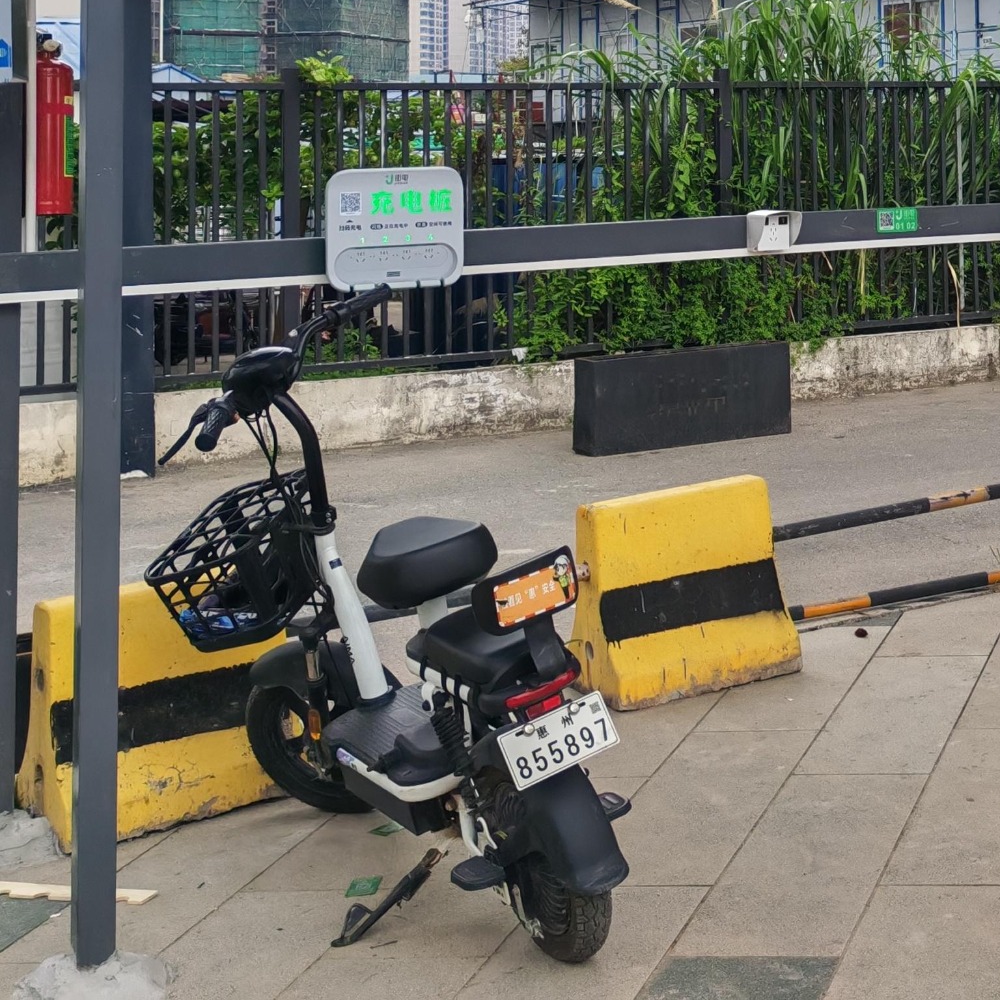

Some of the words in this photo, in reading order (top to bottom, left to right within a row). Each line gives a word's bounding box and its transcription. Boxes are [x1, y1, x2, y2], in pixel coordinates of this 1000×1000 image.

[370, 188, 453, 216] 充电桩
[542, 580, 556, 595] 安全
[536, 714, 574, 740] 惠州
[516, 718, 608, 779] 855897
